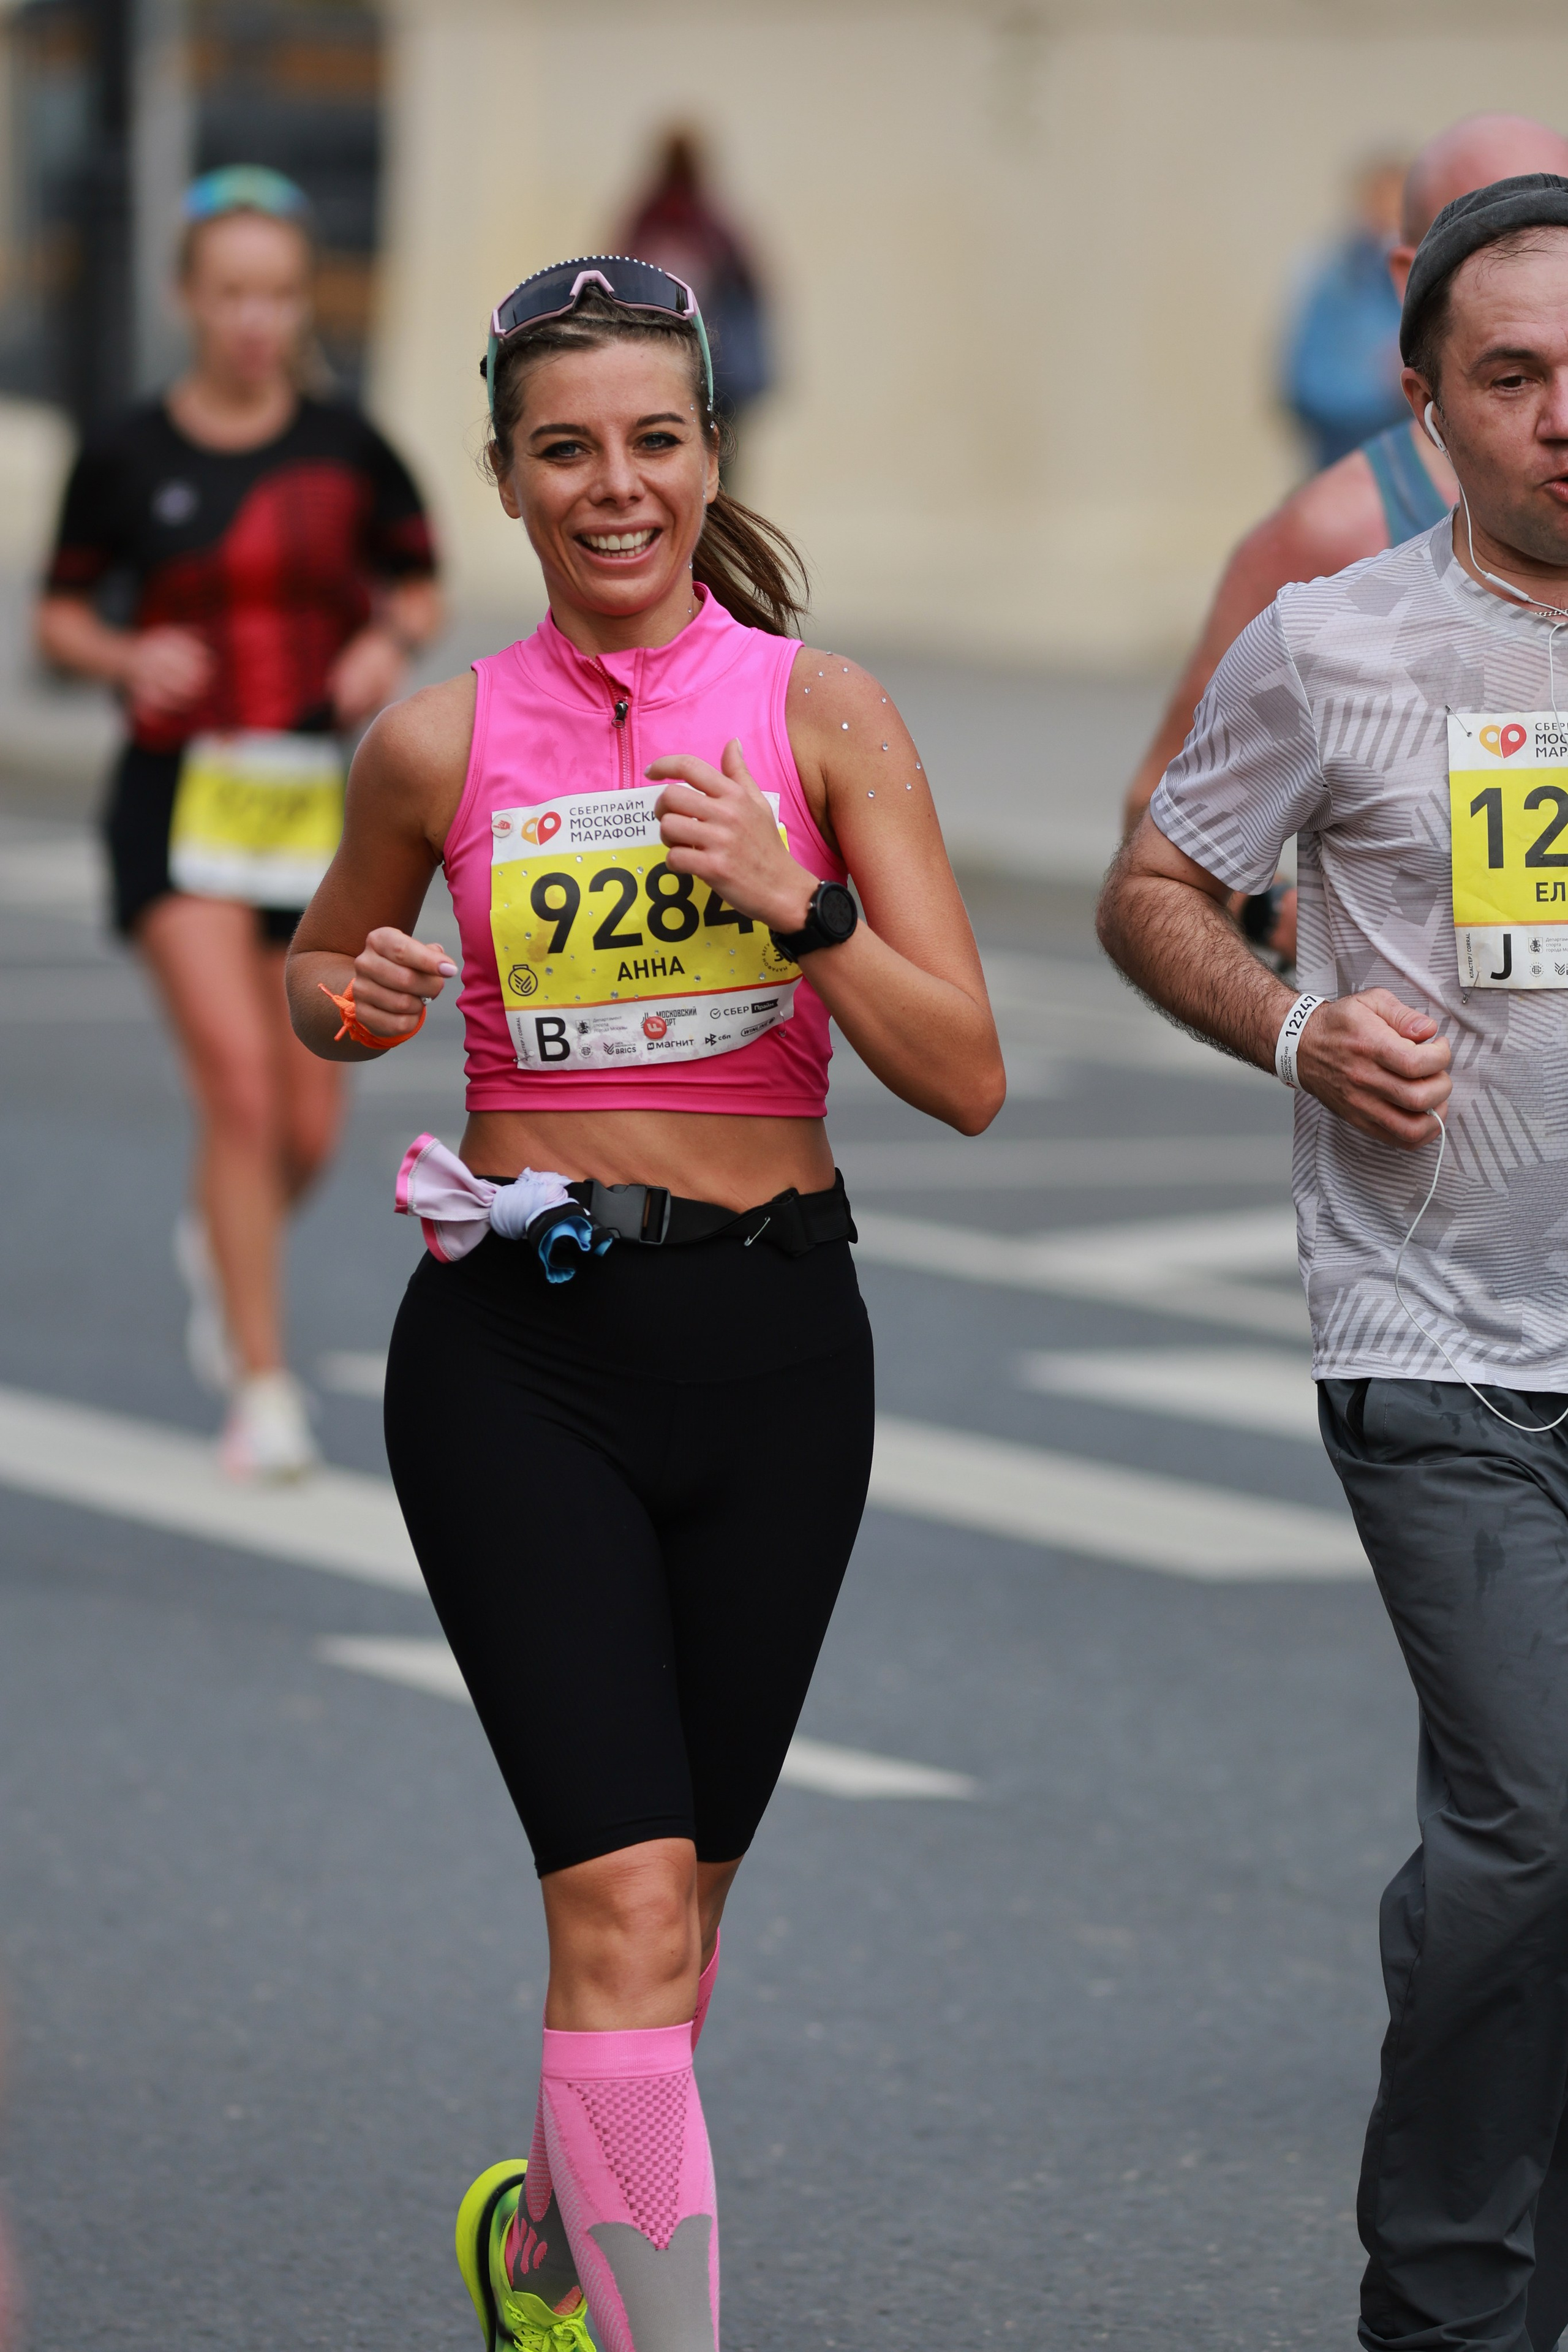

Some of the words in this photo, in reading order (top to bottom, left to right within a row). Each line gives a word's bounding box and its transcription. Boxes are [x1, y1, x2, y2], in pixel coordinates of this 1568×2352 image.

[1535, 722, 1568, 731] СБЕР
[1536, 747, 1568, 758] МАР
[570, 800, 644, 816] СБЕРПРАЙМ
[570, 810, 656, 829] МОСКОВСК
[1471, 785, 1568, 869] 12
[571, 825, 646, 842] МАРАФОН
[1536, 882, 1566, 902] ЕЛ
[1490, 933, 1512, 980] J
[617, 956, 685, 981] АННА
[656, 1006, 698, 1019] МОСКОВСКИЙ
[723, 1006, 749, 1016] СБЕР
[1285, 995, 1317, 1037] 12247
[535, 1017, 570, 1062] B
